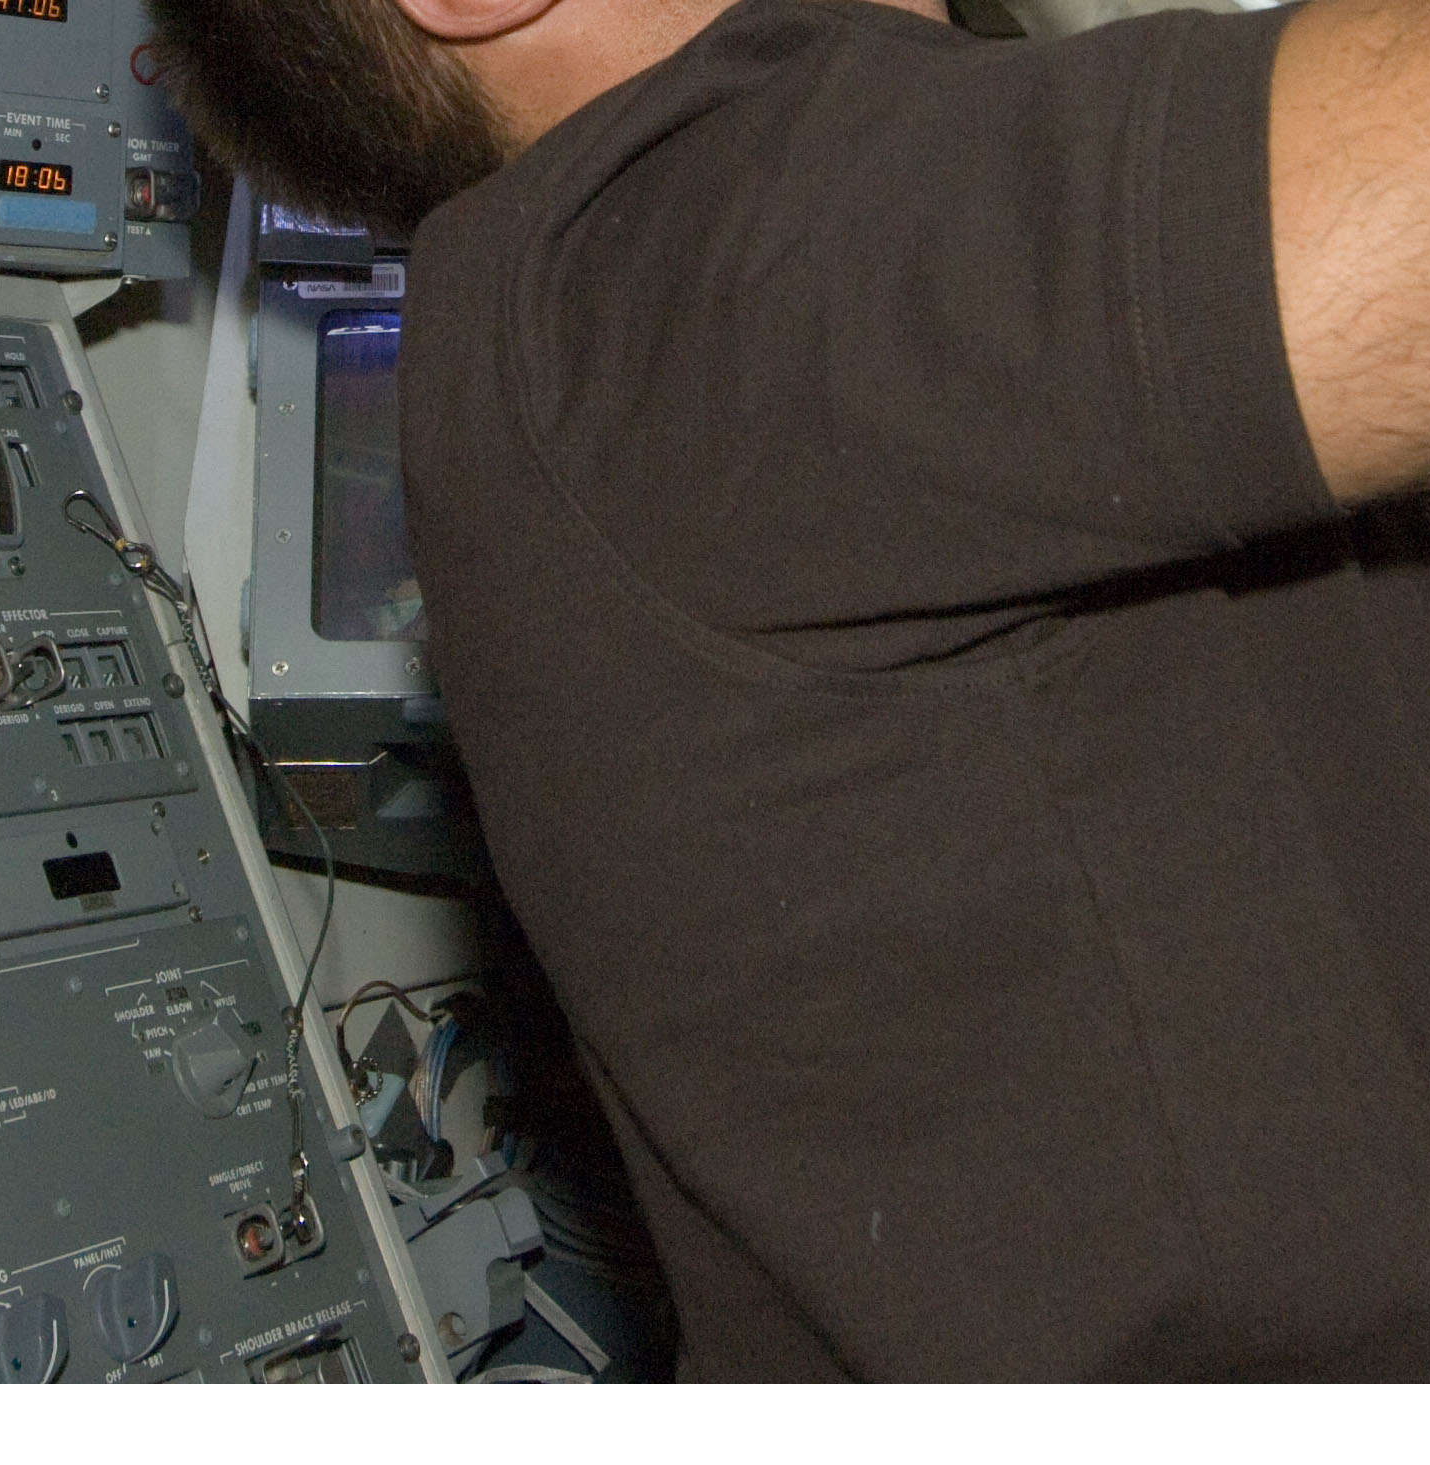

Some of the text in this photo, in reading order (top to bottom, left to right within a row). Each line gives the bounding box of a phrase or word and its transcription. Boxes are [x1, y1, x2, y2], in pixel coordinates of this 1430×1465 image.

[7, 112, 71, 130] EVENT TIME
[4, 128, 71, 143] MIN SEC
[2, 609, 48, 622] EFFECTOR
[96, 625, 129, 637] CAPTURE
[94, 700, 115, 712] OPEN
[155, 968, 182, 984] JOINT
[114, 1005, 155, 1023] SHOULDER
[209, 1161, 265, 1186] SINGLE/DIRECT
[229, 1178, 251, 1193] DRIVE
[73, 1244, 123, 1270] PANEL/INST
[235, 1302, 354, 1357] SHOULDER BRACE RELEASE
